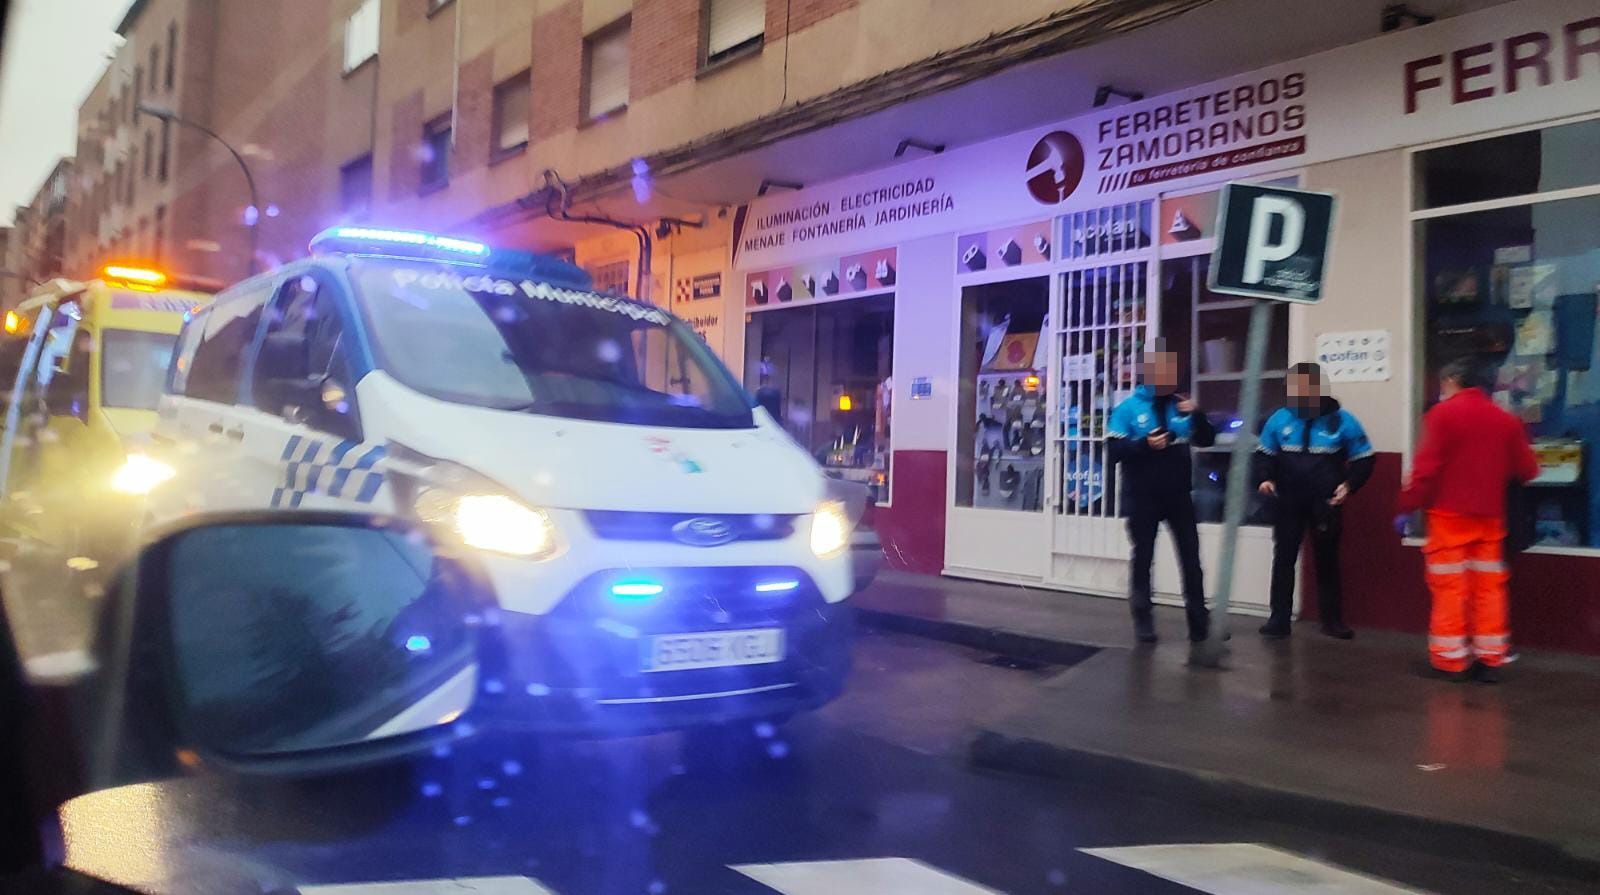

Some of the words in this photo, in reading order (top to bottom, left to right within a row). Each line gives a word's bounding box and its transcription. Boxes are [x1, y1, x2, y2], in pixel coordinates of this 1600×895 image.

[1098, 71, 1306, 143] FERRETEROS
[1097, 105, 1306, 171] ZAMORANOS
[1133, 173, 1146, 184] tu
[1211, 156, 1228, 168] de
[1231, 141, 1300, 164] confianza
[744, 231, 786, 252] MENAJE
[792, 214, 867, 243] FONTANERÍA
[874, 192, 955, 227] JARDINERÍA
[756, 201, 831, 231] ILUMINACIÓN
[840, 177, 936, 212] ELECTRICIDAD
[1241, 194, 1306, 285] P
[1328, 350, 1369, 363] cofan
